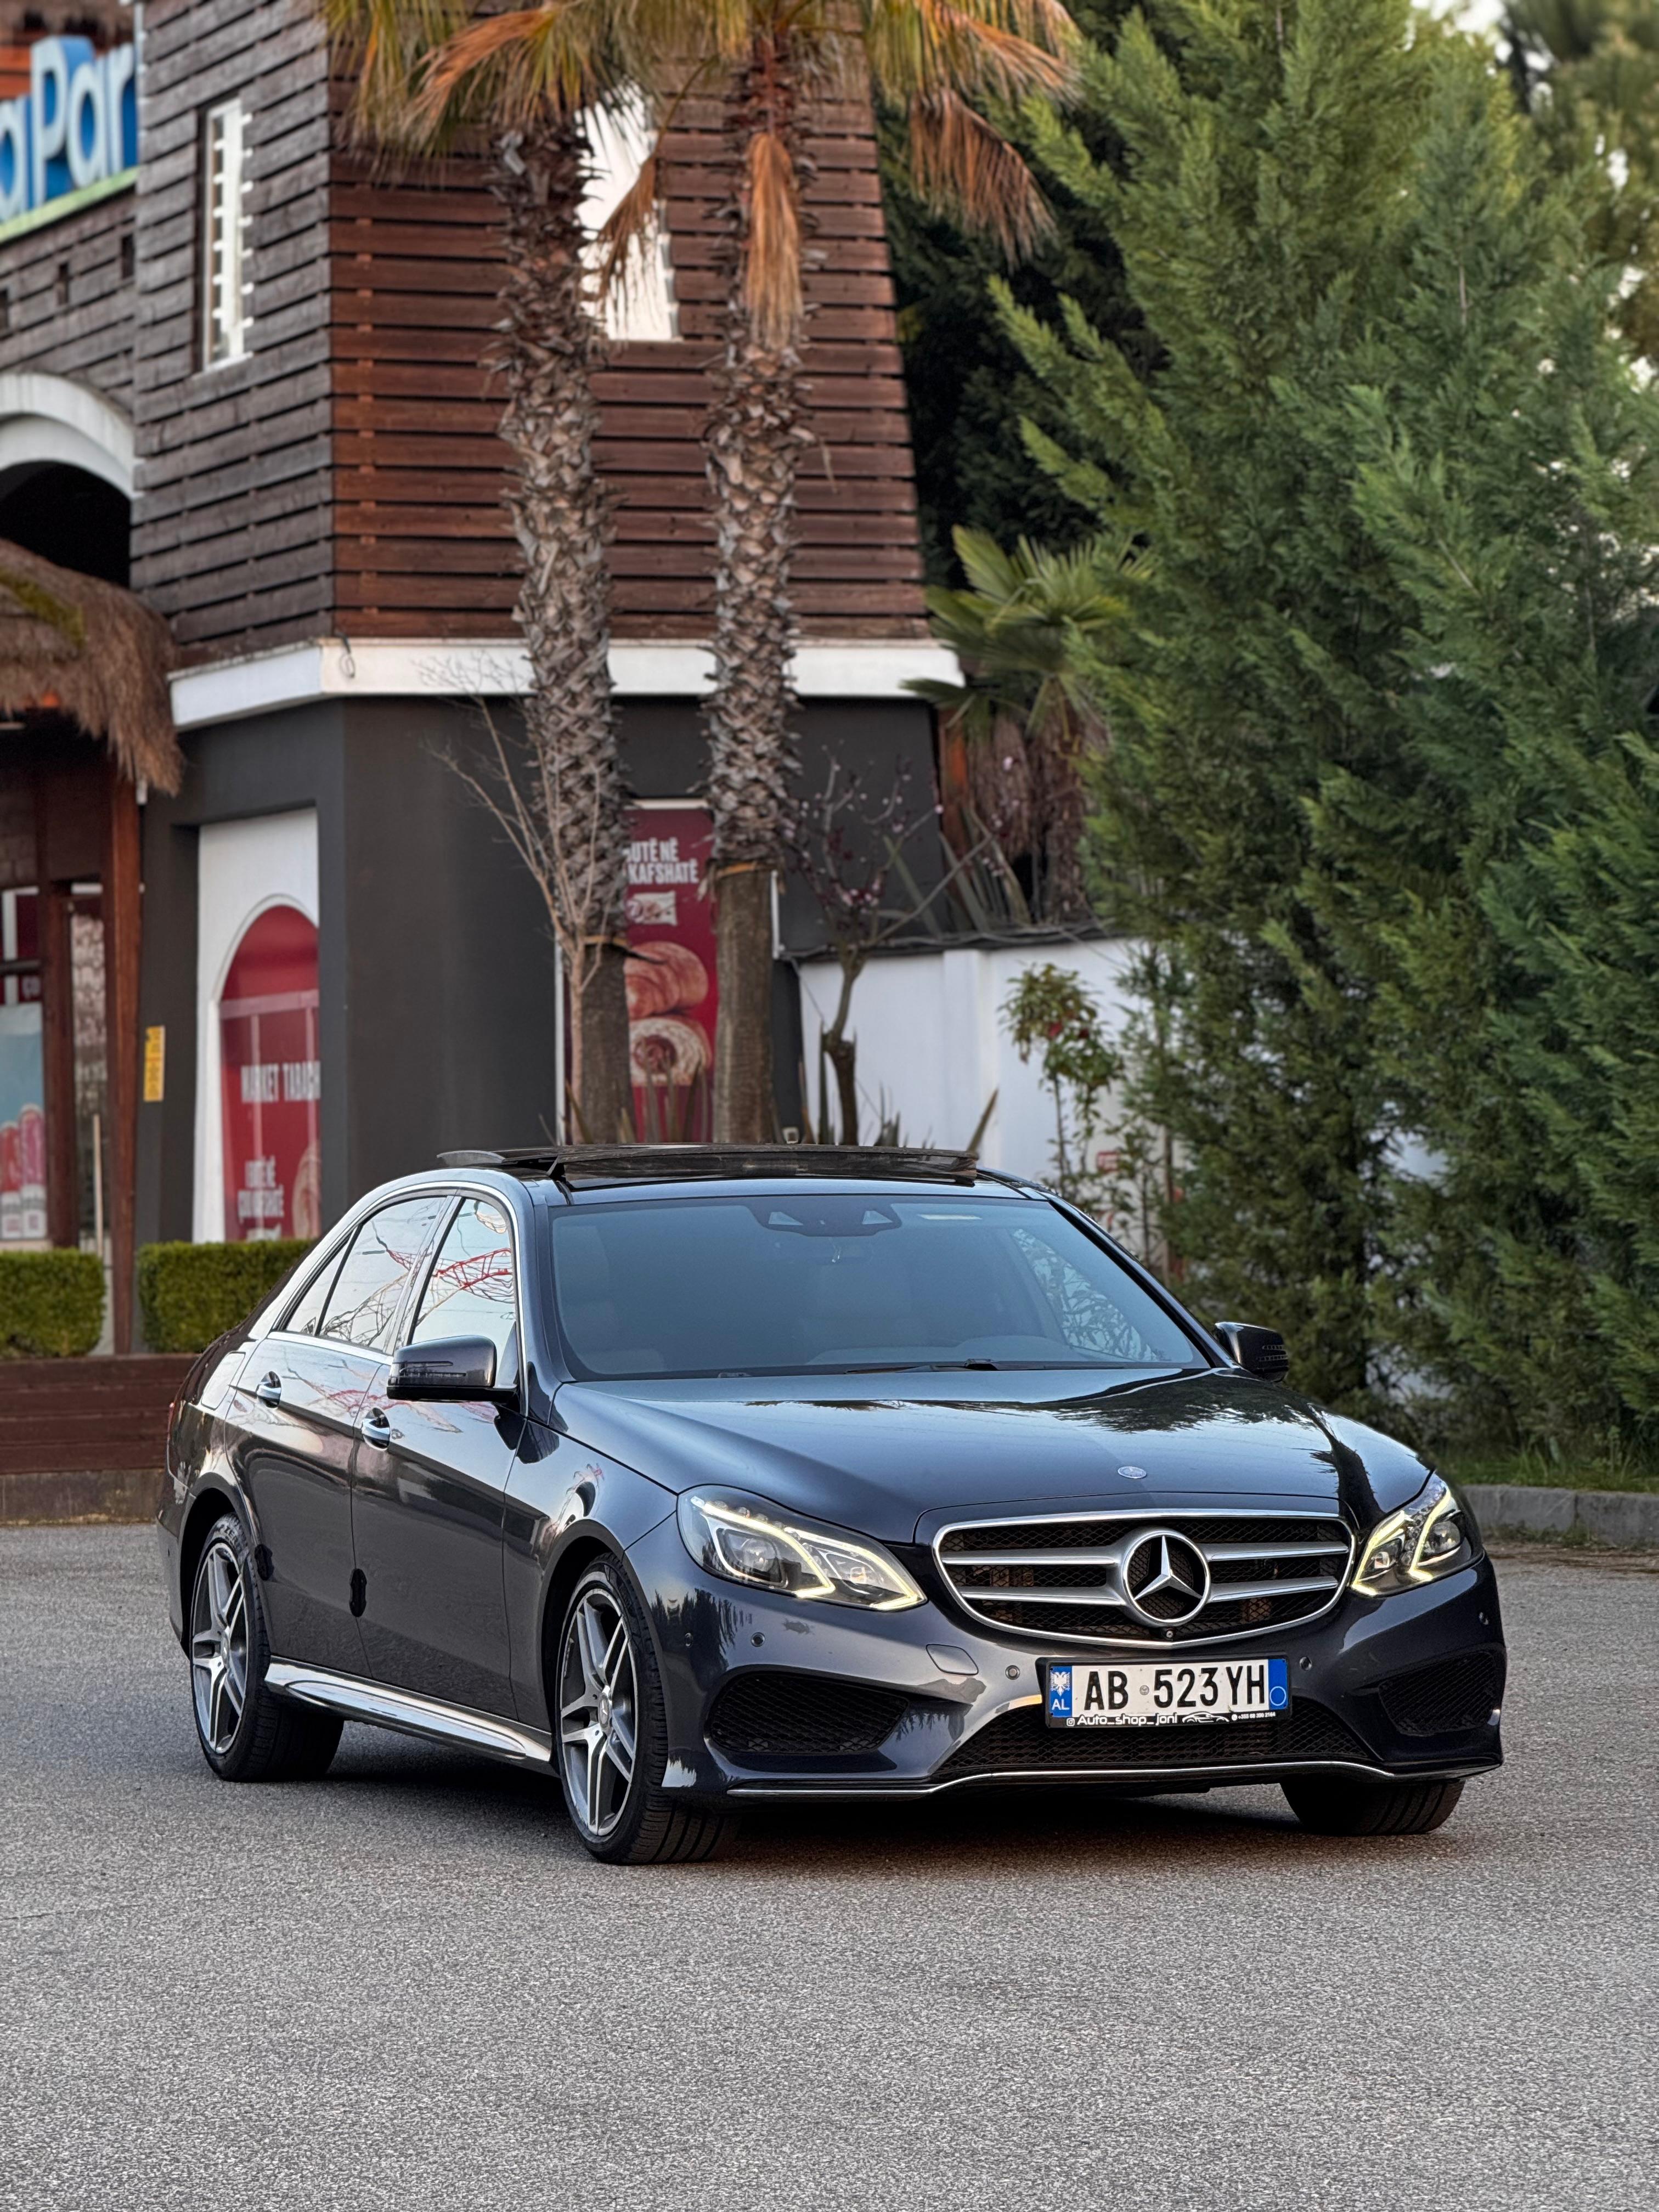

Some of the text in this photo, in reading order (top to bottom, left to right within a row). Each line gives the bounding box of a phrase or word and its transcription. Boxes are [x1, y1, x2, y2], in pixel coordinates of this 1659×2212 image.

[627, 837, 679, 863] UTË NË
[628, 858, 699, 884] KAFSHATË
[1084, 1671, 1128, 1710] AB
[1052, 1699, 1070, 1711] AL
